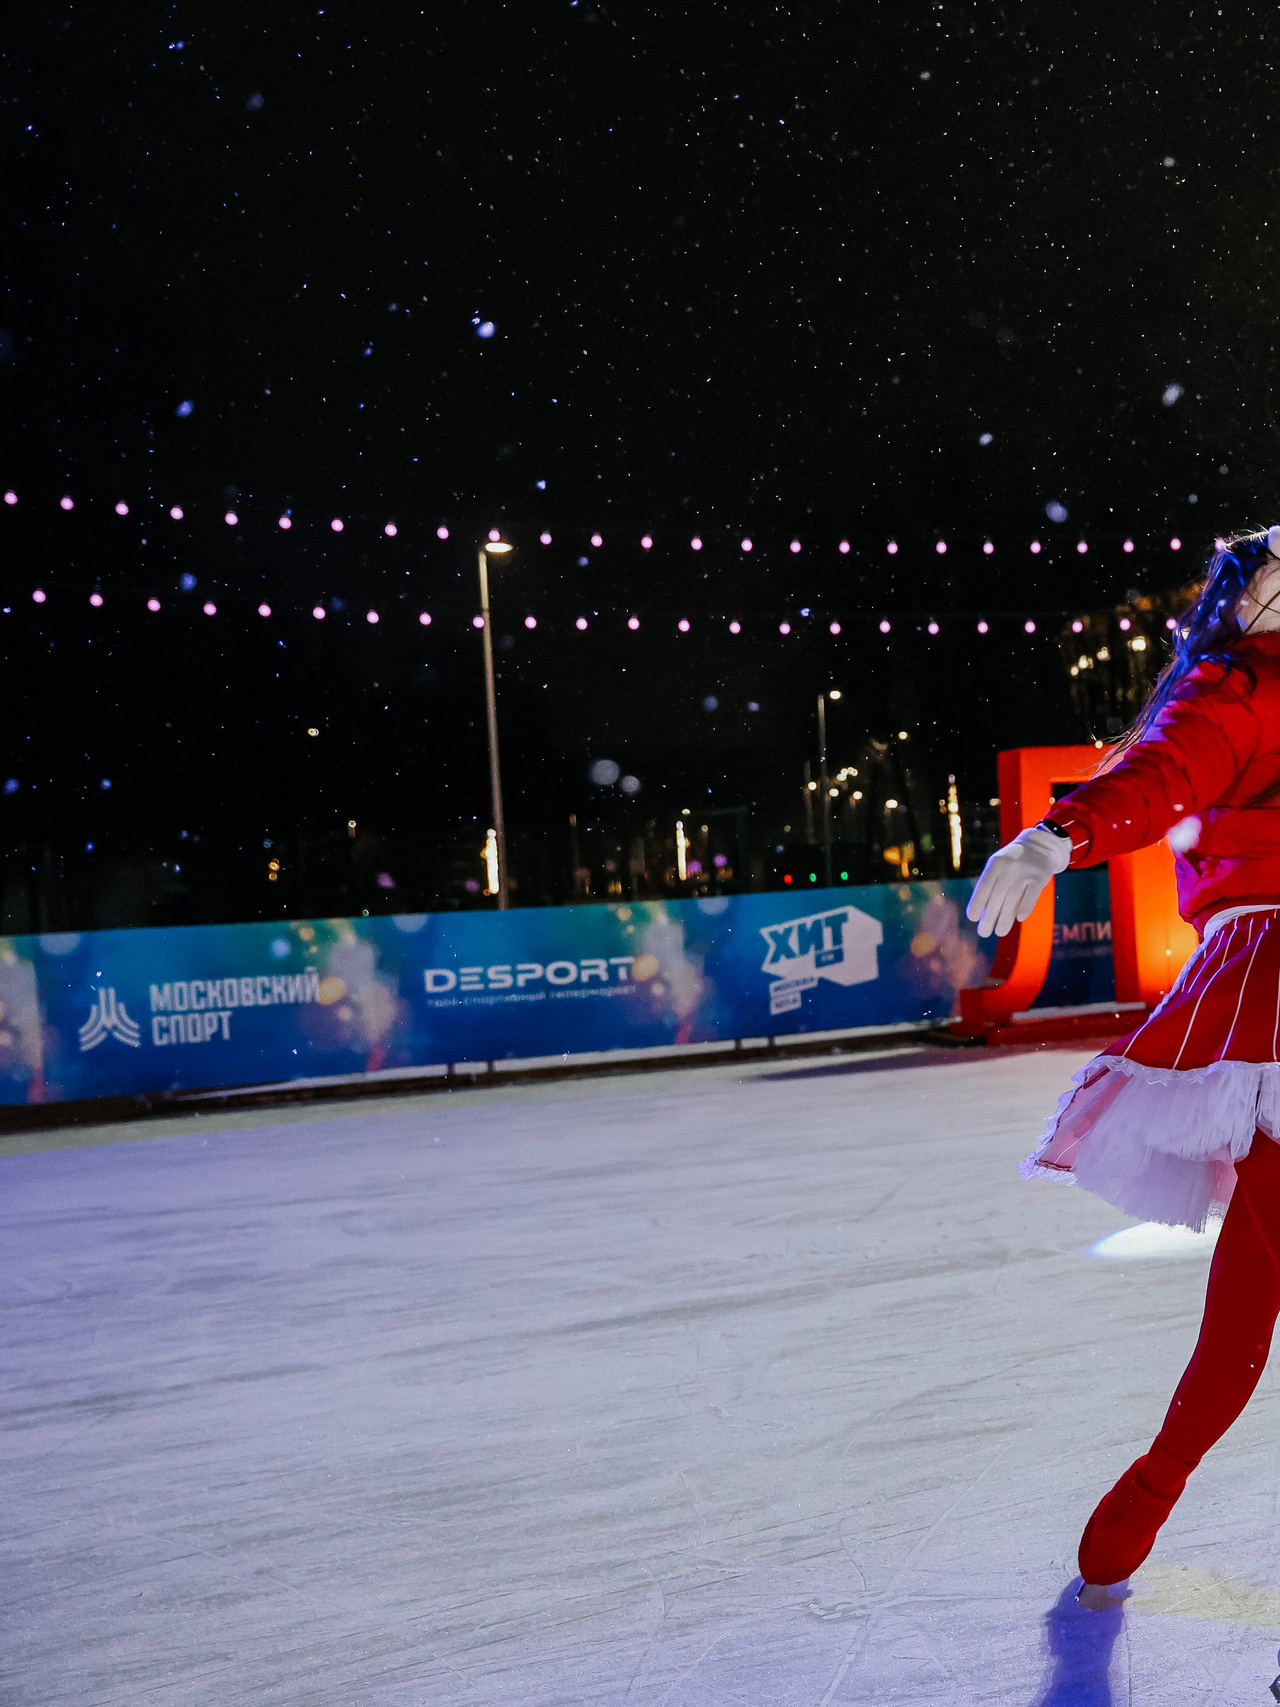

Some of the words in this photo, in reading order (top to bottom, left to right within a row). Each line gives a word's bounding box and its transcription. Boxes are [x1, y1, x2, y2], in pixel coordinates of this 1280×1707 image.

[768, 911, 850, 965] ХИТ
[1052, 921, 1112, 944] ЕМПИ
[150, 966, 321, 1012] МОСКОВСКИЙ
[423, 955, 637, 994] DESPORT
[153, 1010, 233, 1047] СПОРТ
